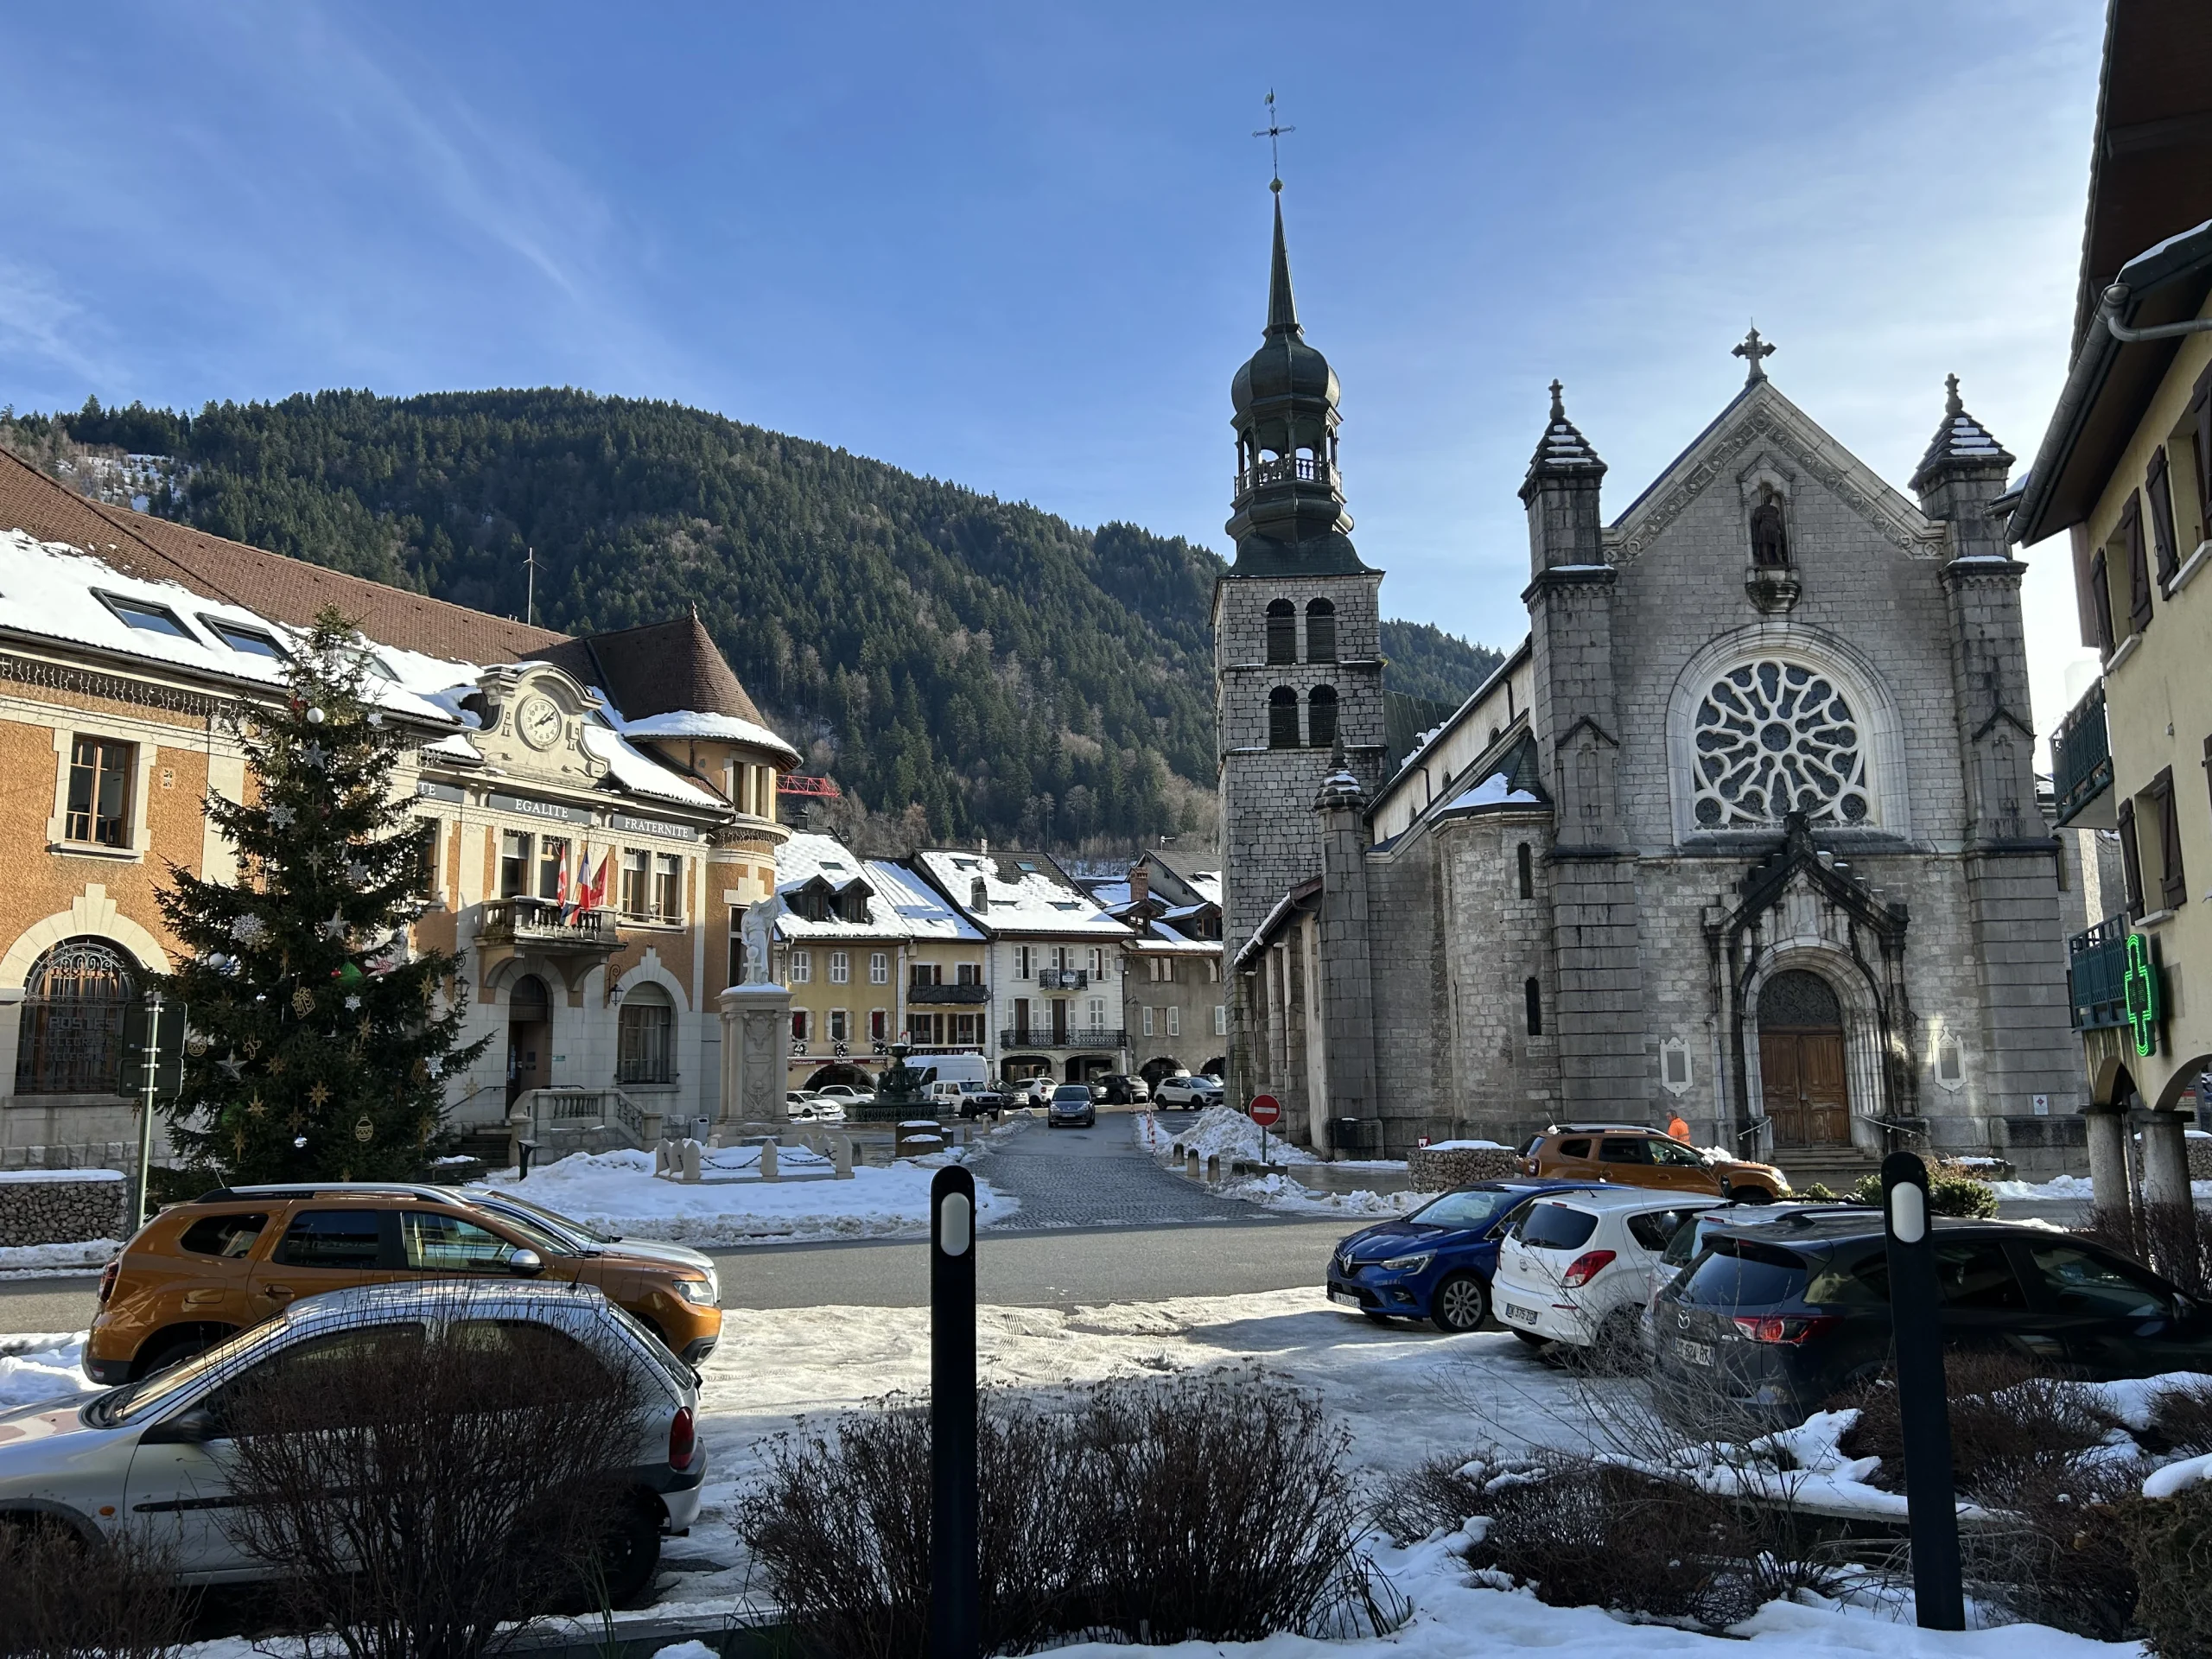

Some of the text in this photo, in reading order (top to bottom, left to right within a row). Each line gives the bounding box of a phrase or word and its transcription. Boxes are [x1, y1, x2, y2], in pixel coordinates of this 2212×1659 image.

[417, 781, 436, 796] TE
[514, 798, 569, 819] EGALITE
[624, 817, 689, 838] FRATERNITE
